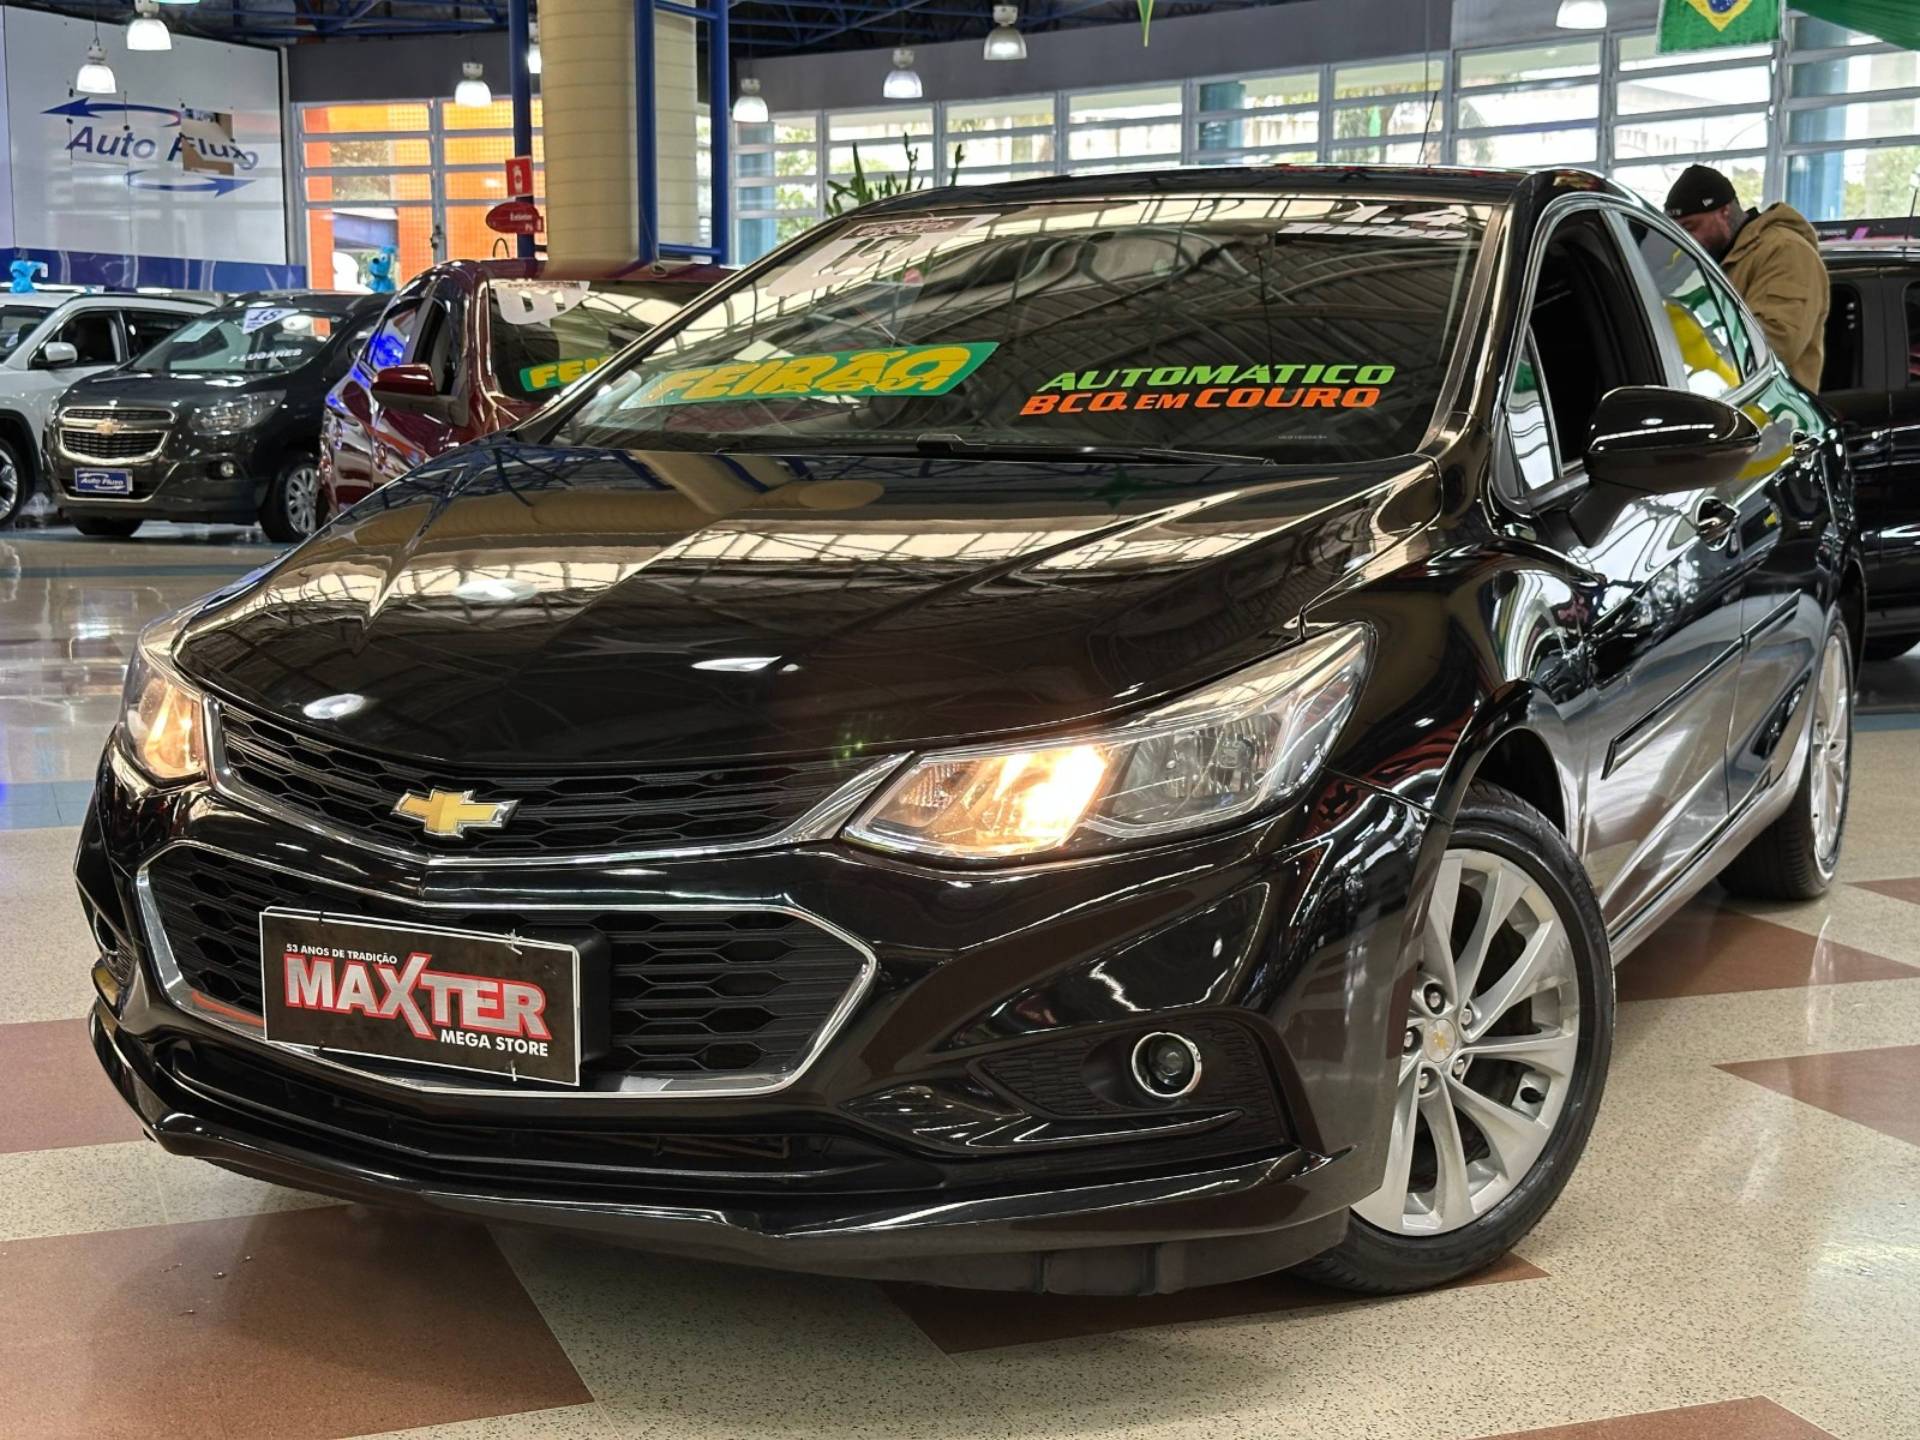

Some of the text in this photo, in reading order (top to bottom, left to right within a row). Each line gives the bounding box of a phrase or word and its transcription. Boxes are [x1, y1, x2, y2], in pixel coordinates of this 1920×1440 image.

[66, 126, 259, 171] Auto Fluxo
[239, 348, 303, 362] LUGARES
[643, 346, 971, 400] FEIRÃO
[1134, 393, 1190, 410] EM
[1194, 387, 1381, 408] COURO
[286, 943, 398, 964] 53 ANOS DE TRADIÇÃO
[283, 952, 552, 1040] MAXTER
[440, 1029, 549, 1057] MEGA STORE
